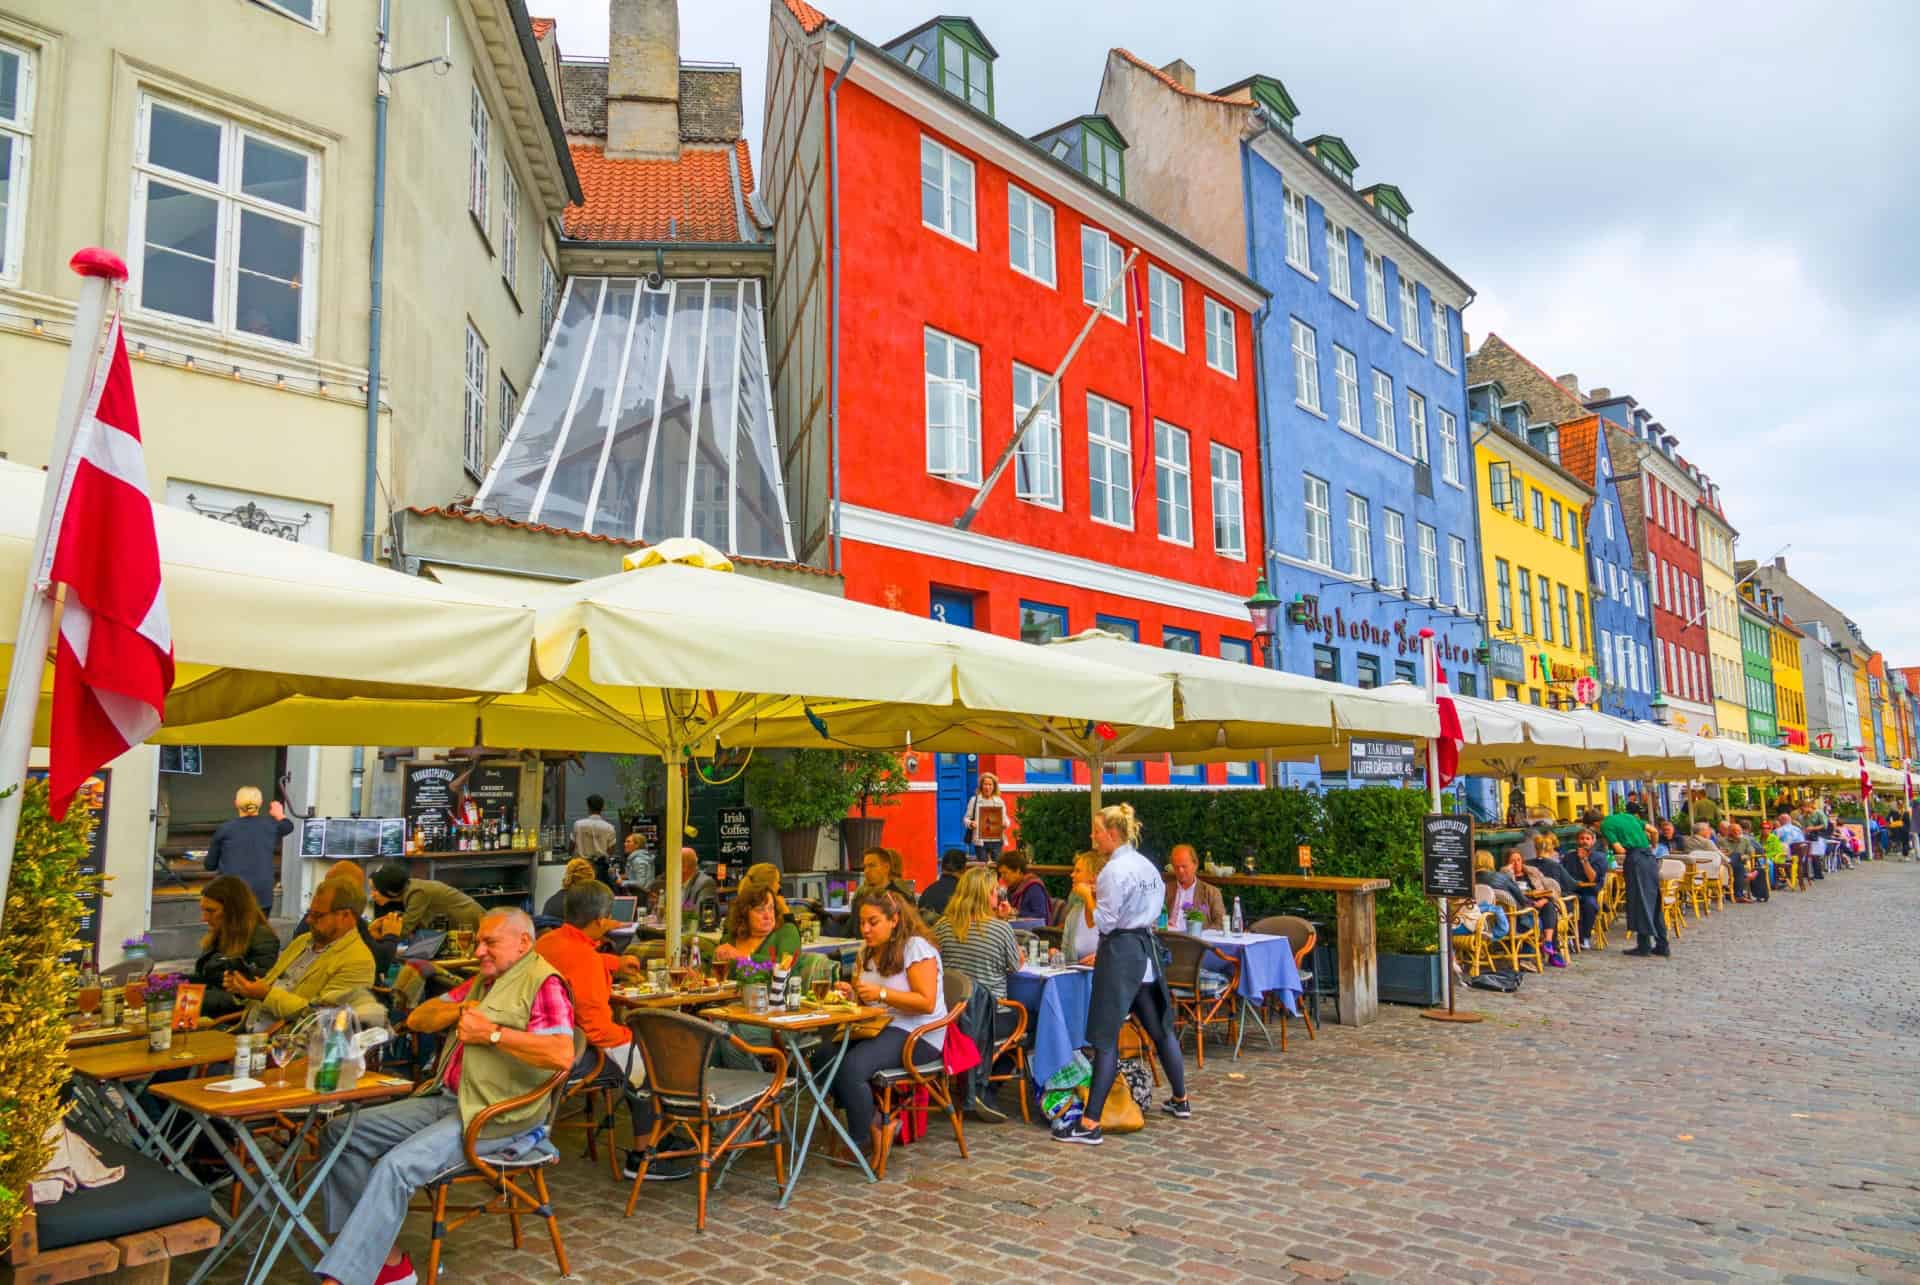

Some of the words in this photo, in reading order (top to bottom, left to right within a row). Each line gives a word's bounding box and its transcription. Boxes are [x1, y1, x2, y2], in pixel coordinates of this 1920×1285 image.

[1816, 732, 1833, 749] 17
[1367, 743, 1384, 755] TAKE
[723, 811, 745, 823] Irish
[720, 824, 750, 835] Coffee
